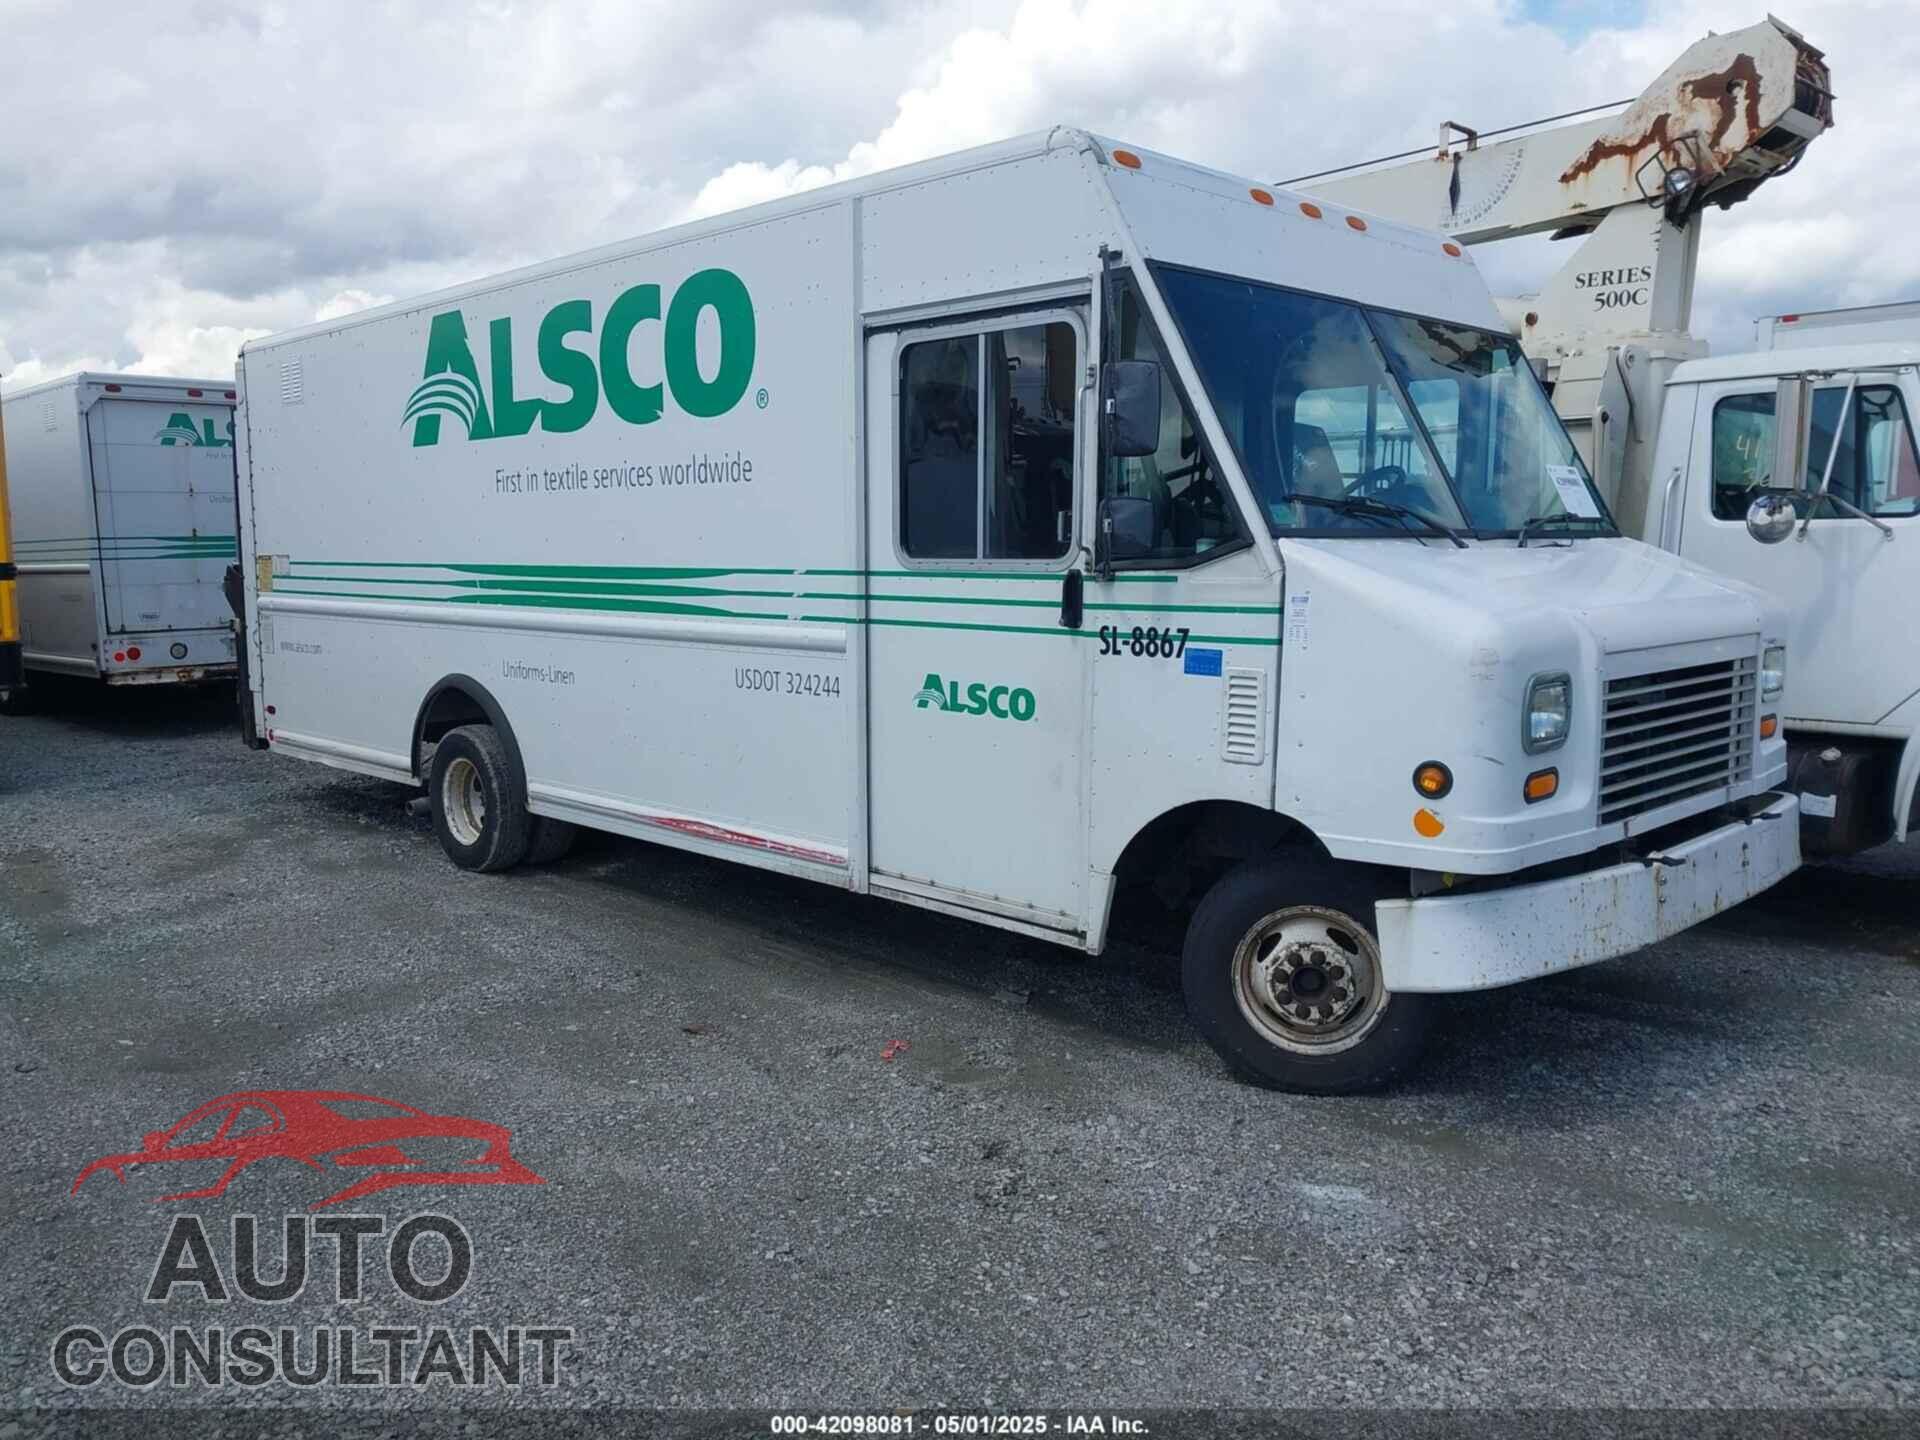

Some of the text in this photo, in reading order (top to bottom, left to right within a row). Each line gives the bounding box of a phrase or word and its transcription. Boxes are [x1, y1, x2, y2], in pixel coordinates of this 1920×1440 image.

[1574, 265, 1652, 290] SERIES
[1593, 287, 1649, 312] 500C
[401, 268, 756, 448] ALSCO
[155, 412, 233, 448] AL
[495, 450, 753, 494] First in textile services worldwide
[1099, 624, 1190, 659] SL-8867
[502, 659, 576, 686] Uniforms-Linen
[734, 667, 840, 698] USDOT 324244
[914, 673, 1036, 721] ALSCO
